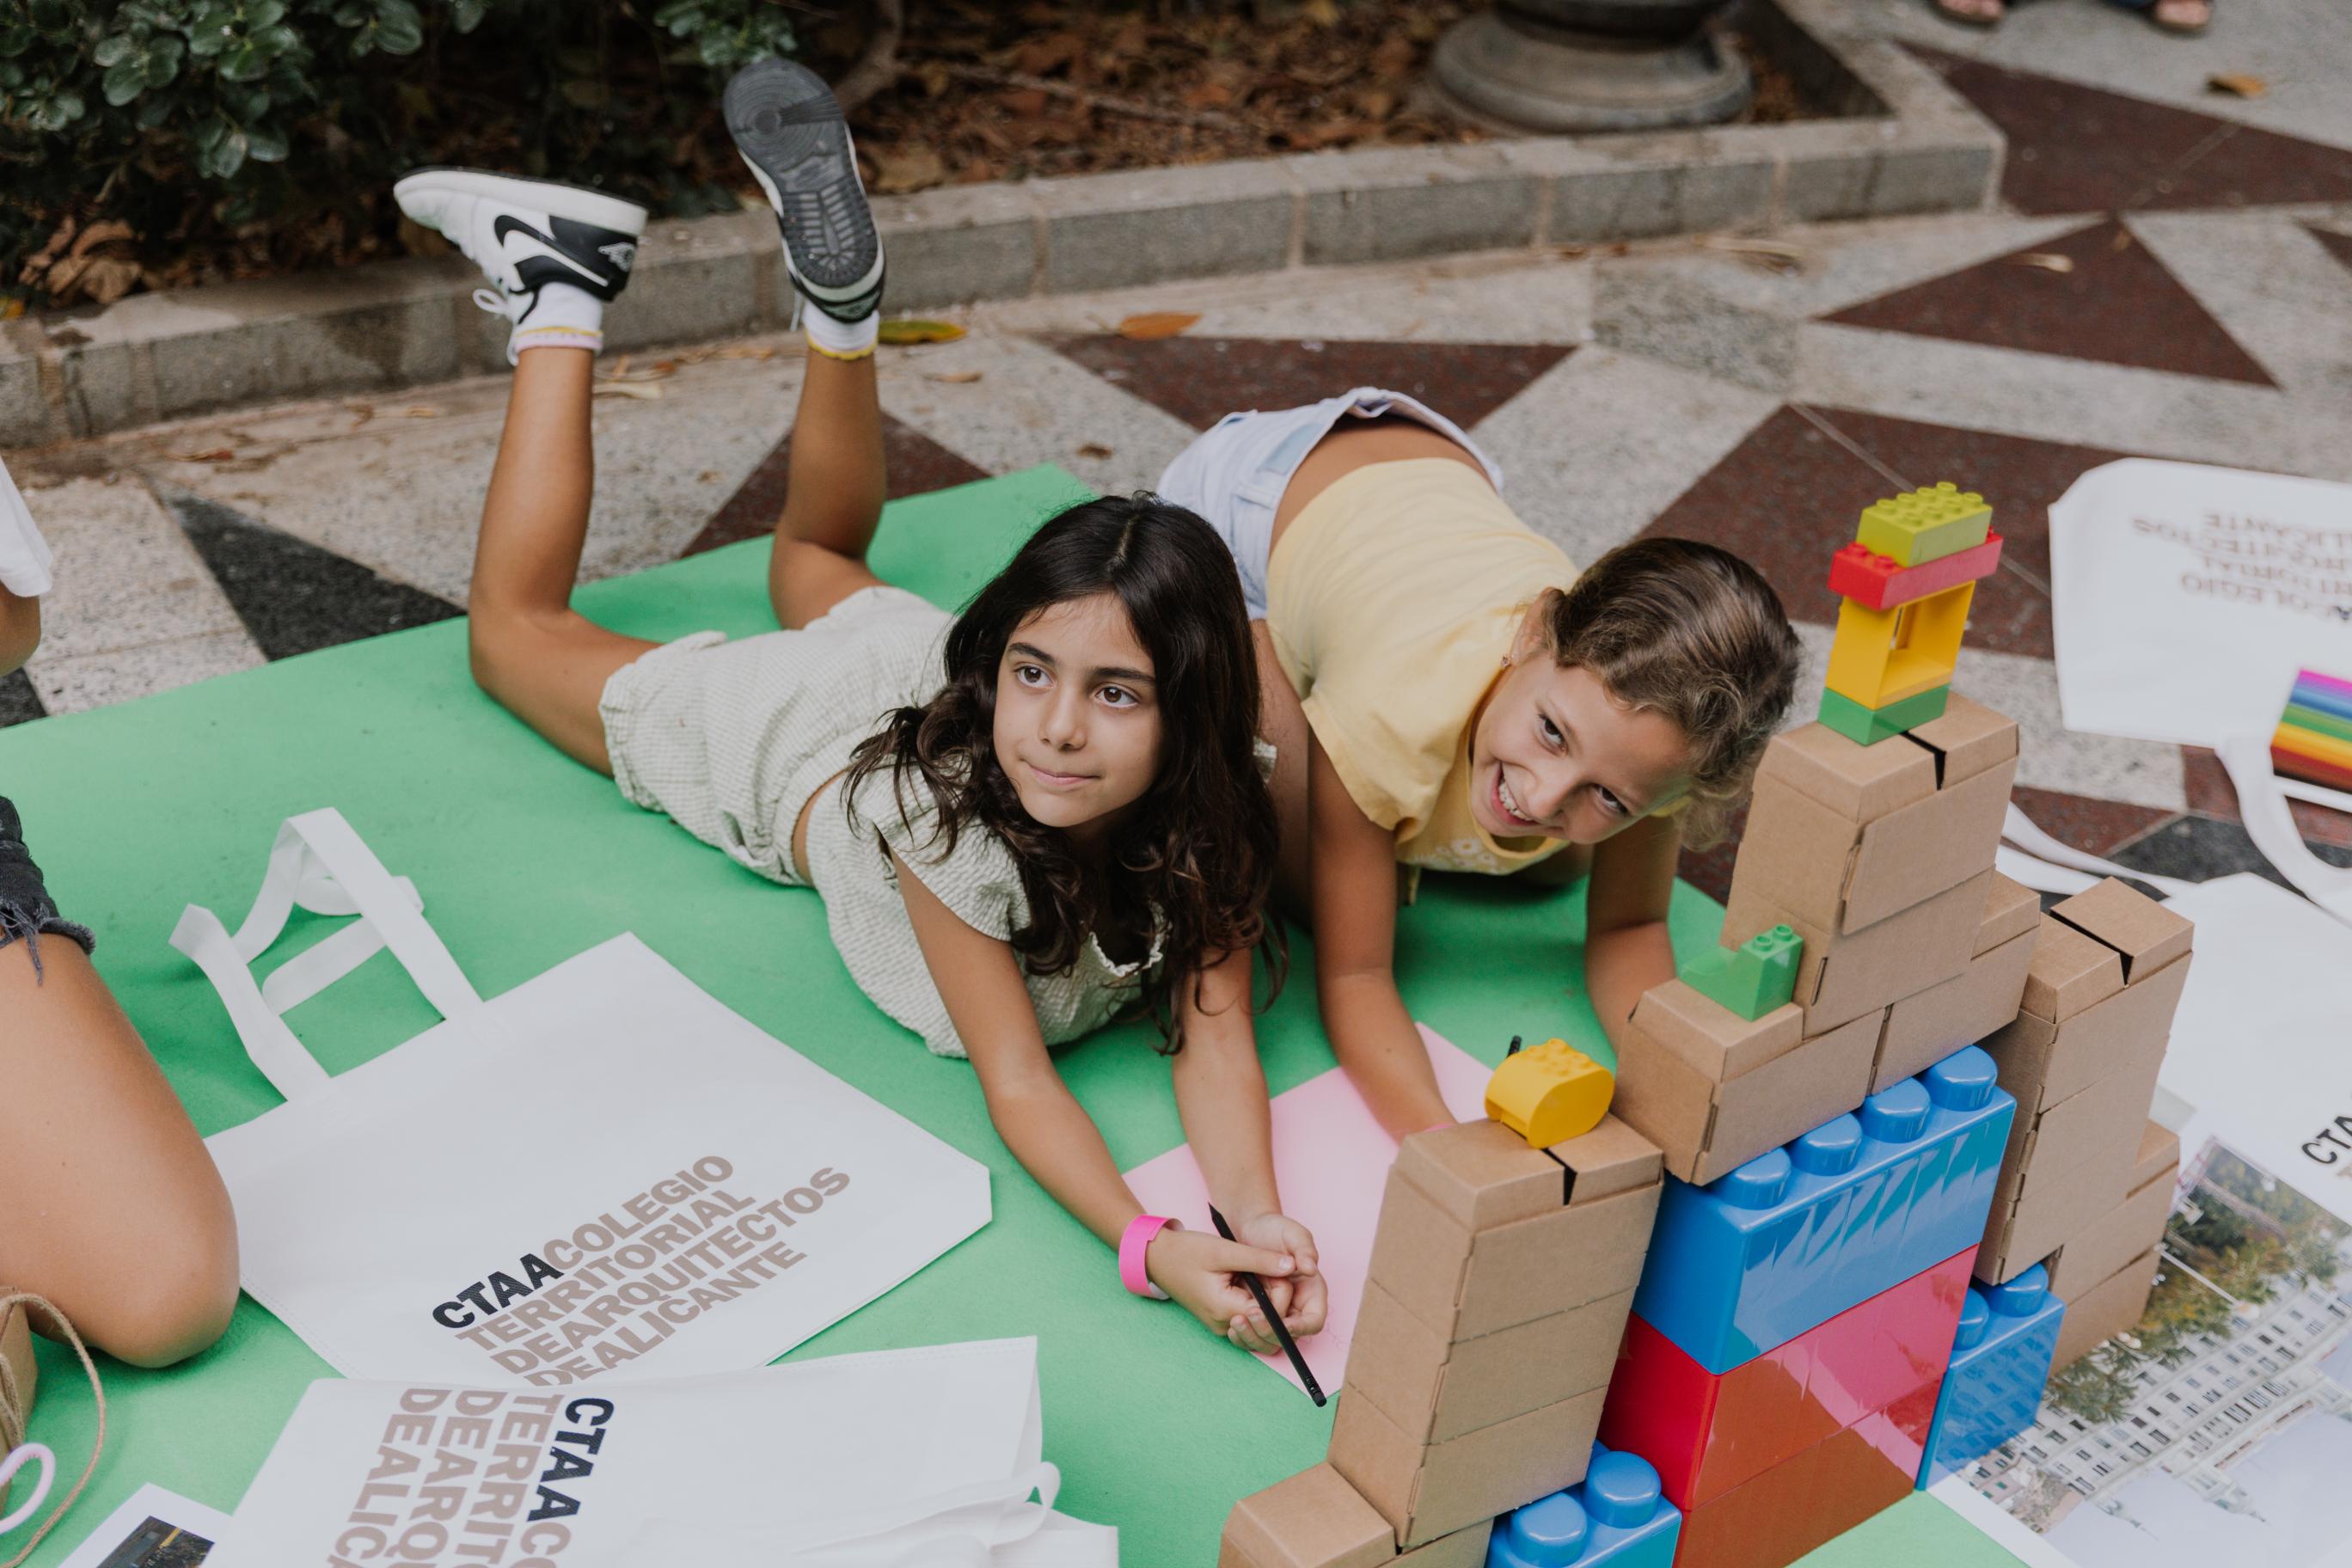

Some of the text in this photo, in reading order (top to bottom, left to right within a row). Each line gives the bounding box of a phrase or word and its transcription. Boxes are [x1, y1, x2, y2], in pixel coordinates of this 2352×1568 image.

[432, 1253, 564, 1329] CTAA
[454, 1190, 756, 1351] TERRITORIAL
[451, 1393, 567, 1568] TERRIT
[527, 1397, 615, 1522] CTAA
